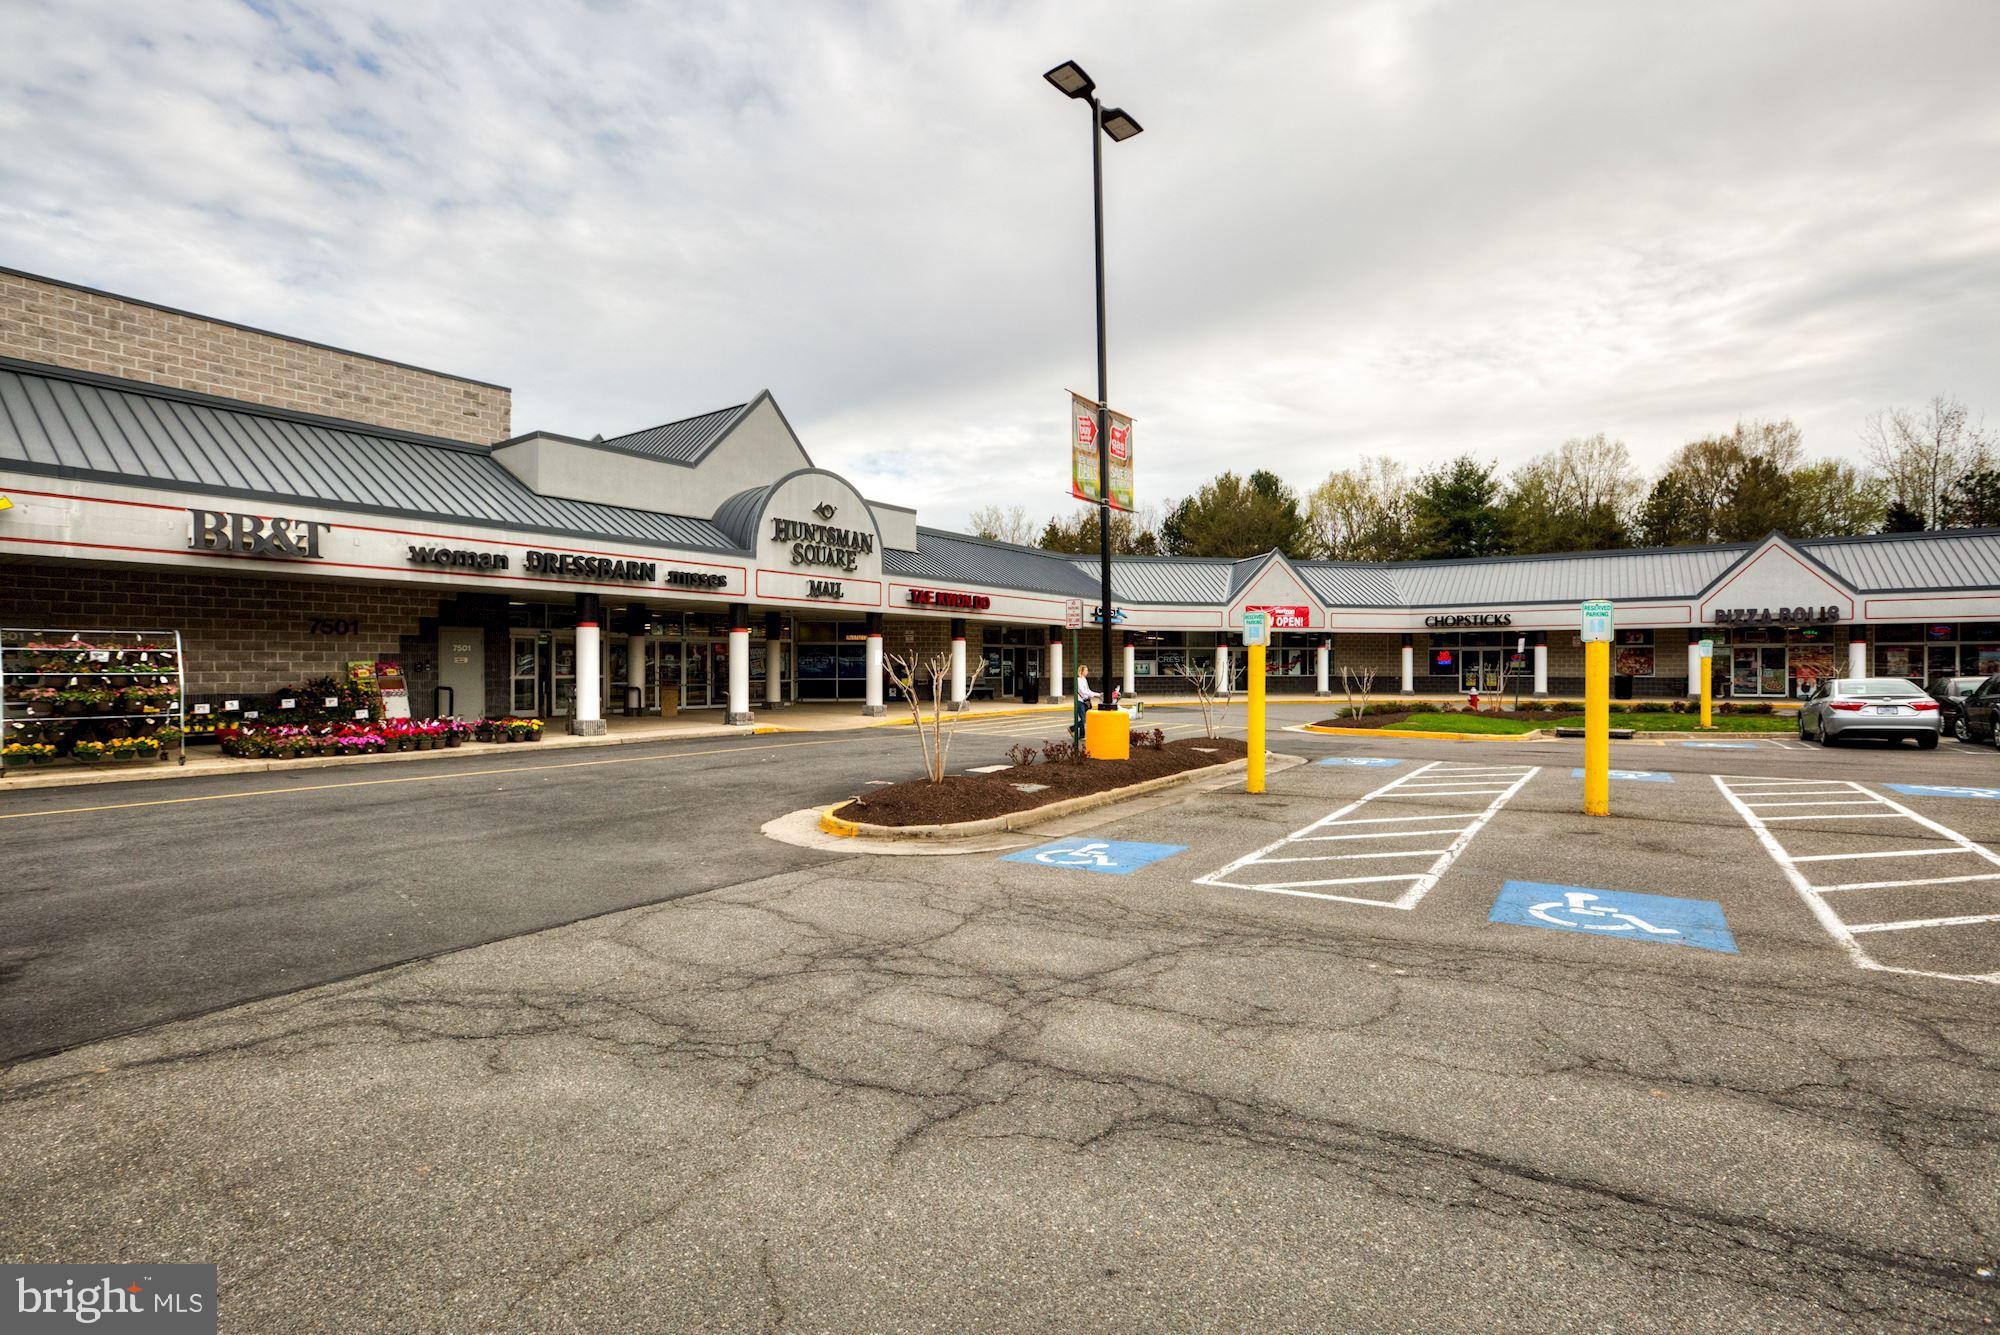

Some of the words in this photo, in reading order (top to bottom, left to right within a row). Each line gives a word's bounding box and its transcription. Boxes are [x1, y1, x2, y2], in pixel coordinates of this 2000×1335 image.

[188, 508, 331, 559] BB&T
[771, 517, 874, 555] HUNTSMAN
[407, 545, 509, 570] woman
[524, 550, 656, 582] DRESSBARN
[791, 543, 858, 572] SQUARE
[666, 568, 727, 587] misses
[908, 589, 934, 605] TAE
[936, 591, 972, 608] KWON
[973, 595, 990, 610] DO
[1276, 617, 1304, 627] OPEN!
[1425, 613, 1512, 627] CHOPSTICKS
[1715, 608, 1772, 625] PIZZA
[308, 617, 360, 636] 7501
[453, 644, 471, 652] 7501
[1158, 655, 1186, 663] CREST
